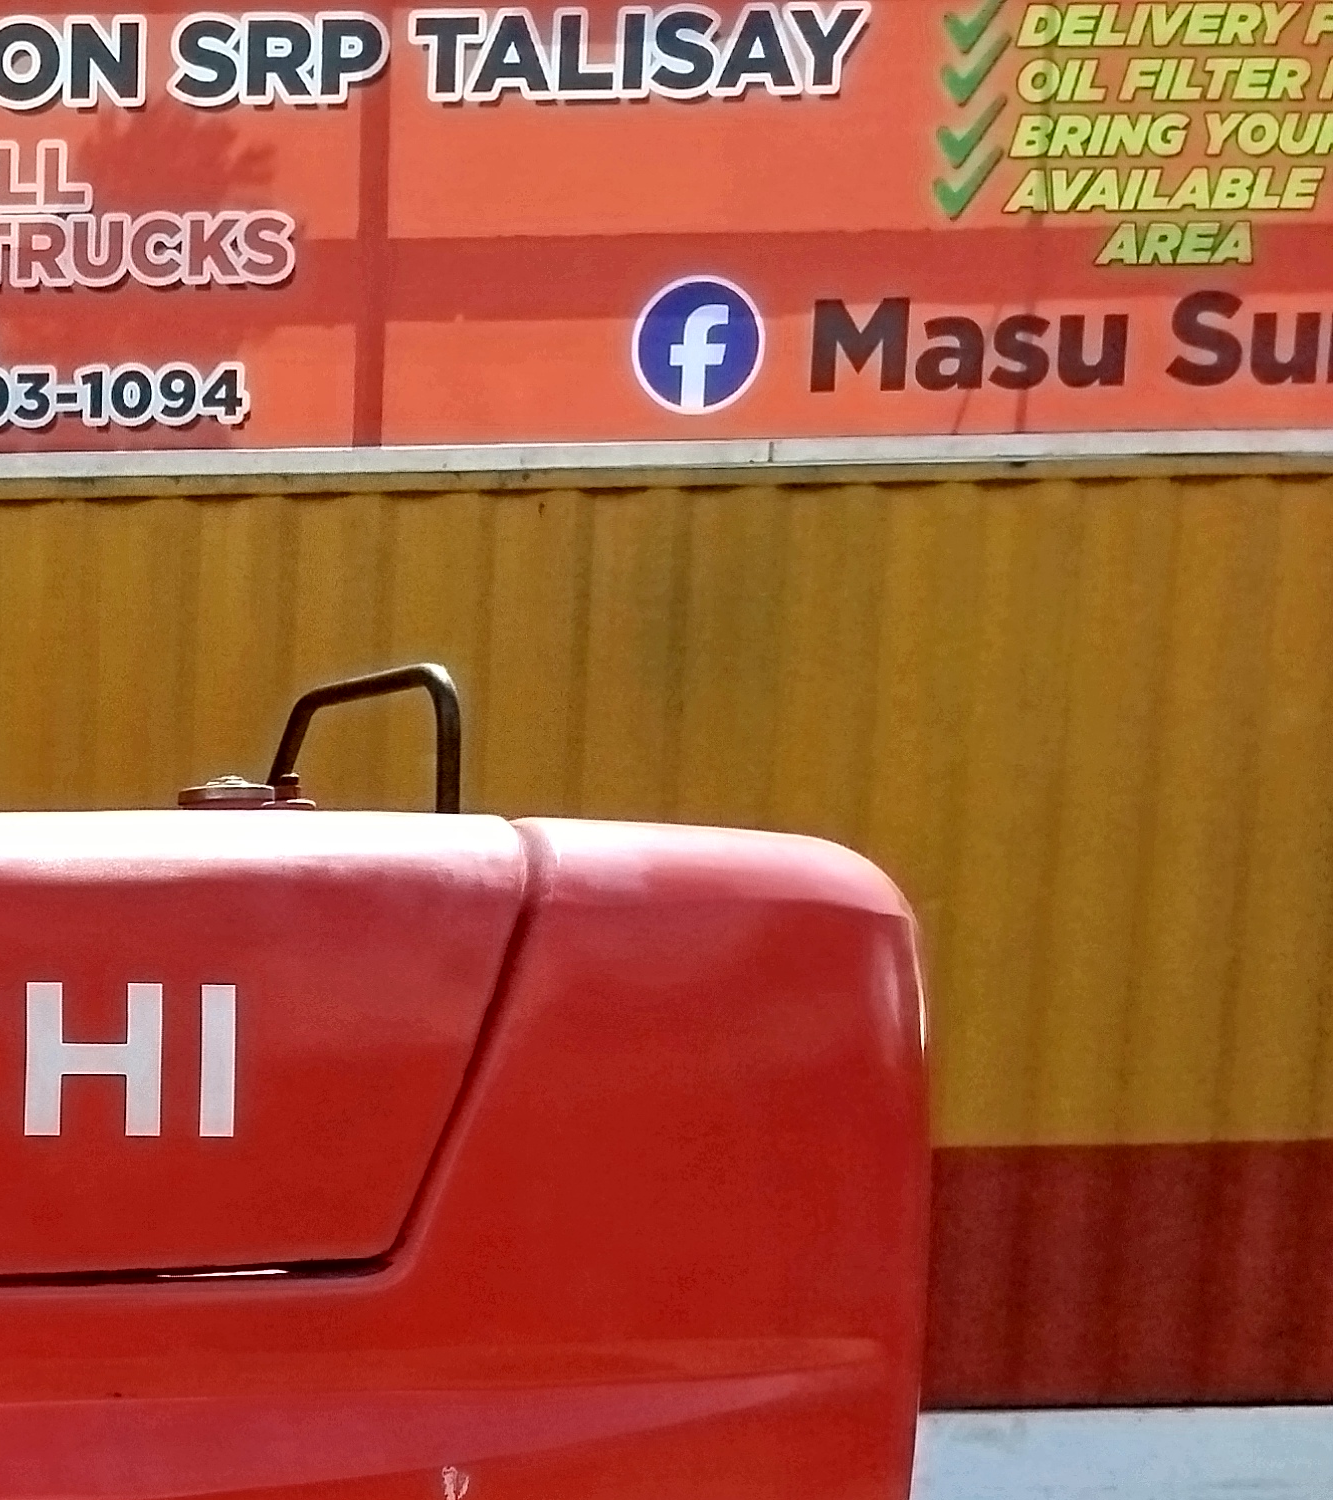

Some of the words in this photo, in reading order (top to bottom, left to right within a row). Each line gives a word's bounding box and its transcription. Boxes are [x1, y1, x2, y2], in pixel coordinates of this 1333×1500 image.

[1016, 2, 1302, 47] DELIVERY
[171, 10, 389, 105] SRP
[410, 3, 870, 102] TALISAY
[1016, 58, 1107, 103] OIL
[1118, 57, 1311, 101] FILTER
[1009, 112, 1190, 158] BRING
[1002, 166, 1324, 213] AVAILABLE
[1093, 221, 1254, 266] AREA
[810, 297, 1129, 392] Masu
[1166, 290, 1333, 387] Su
